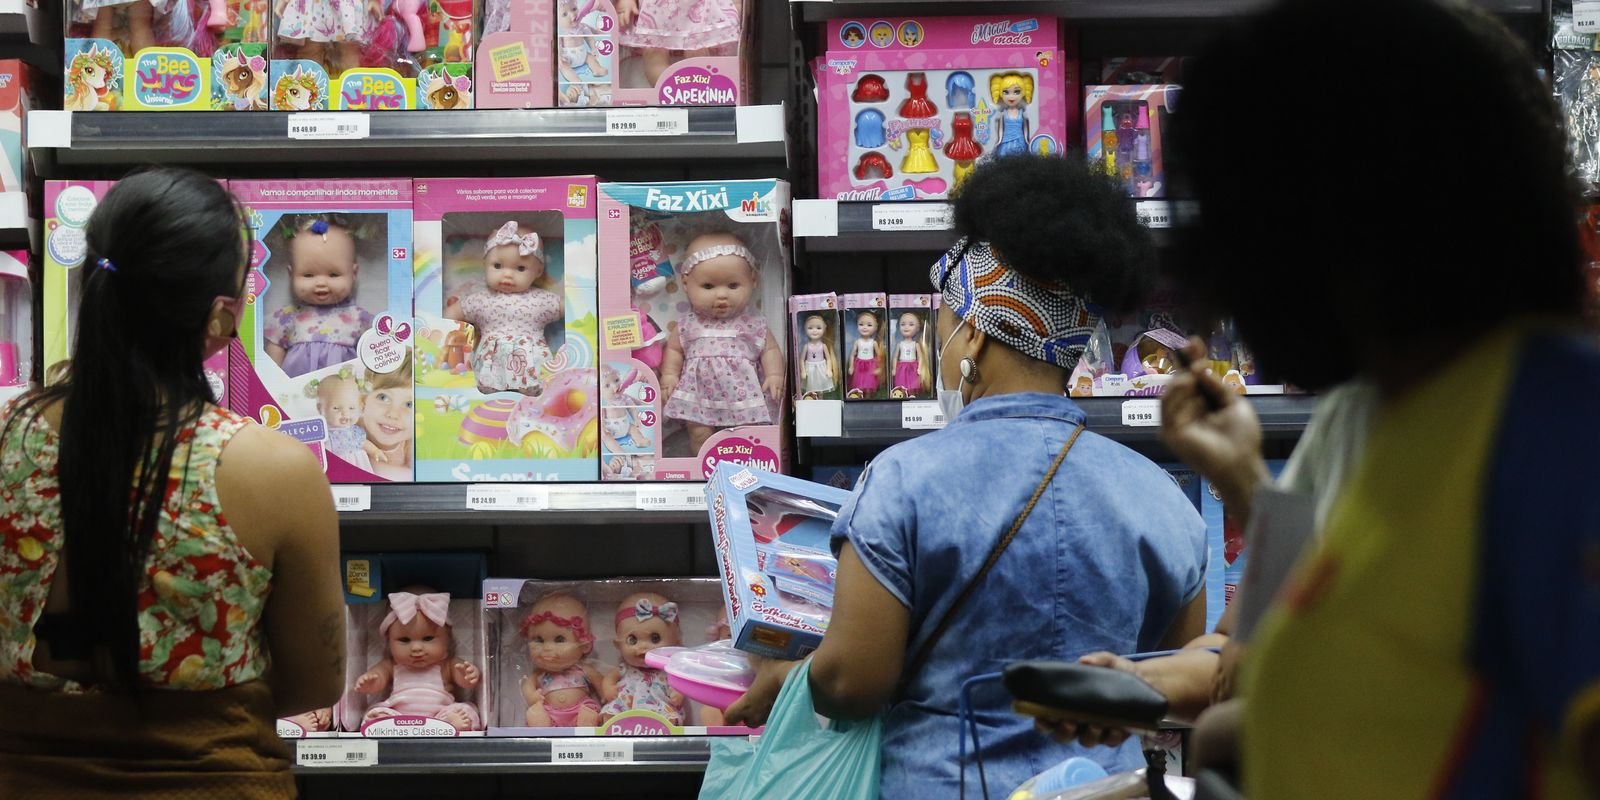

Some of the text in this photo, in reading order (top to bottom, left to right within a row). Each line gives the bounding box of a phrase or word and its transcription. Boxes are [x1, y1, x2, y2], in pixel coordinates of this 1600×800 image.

[993, 32, 1032, 45] moda
[142, 55, 190, 75] The Bee
[674, 74, 711, 85] Faz Xixi
[347, 76, 395, 95] The Bee
[662, 86, 735, 104] SAPEKINHA
[612, 122, 636, 130] R$ 29.99
[260, 188, 398, 197] Vamos compartilhar lindos momentos
[645, 186, 728, 211] Faz Xixi
[610, 210, 620, 218] 3+
[393, 249, 406, 258] 3+
[370, 339, 390, 350] Quero
[374, 346, 390, 355] ficar
[384, 350, 396, 358] seu
[374, 354, 400, 369] colinho!
[717, 445, 753, 455] Faz Xixi
[396, 718, 423, 726] COLEÇÃO
[278, 728, 300, 736] sicas
[368, 726, 454, 736] Milkinhas Clássicas
